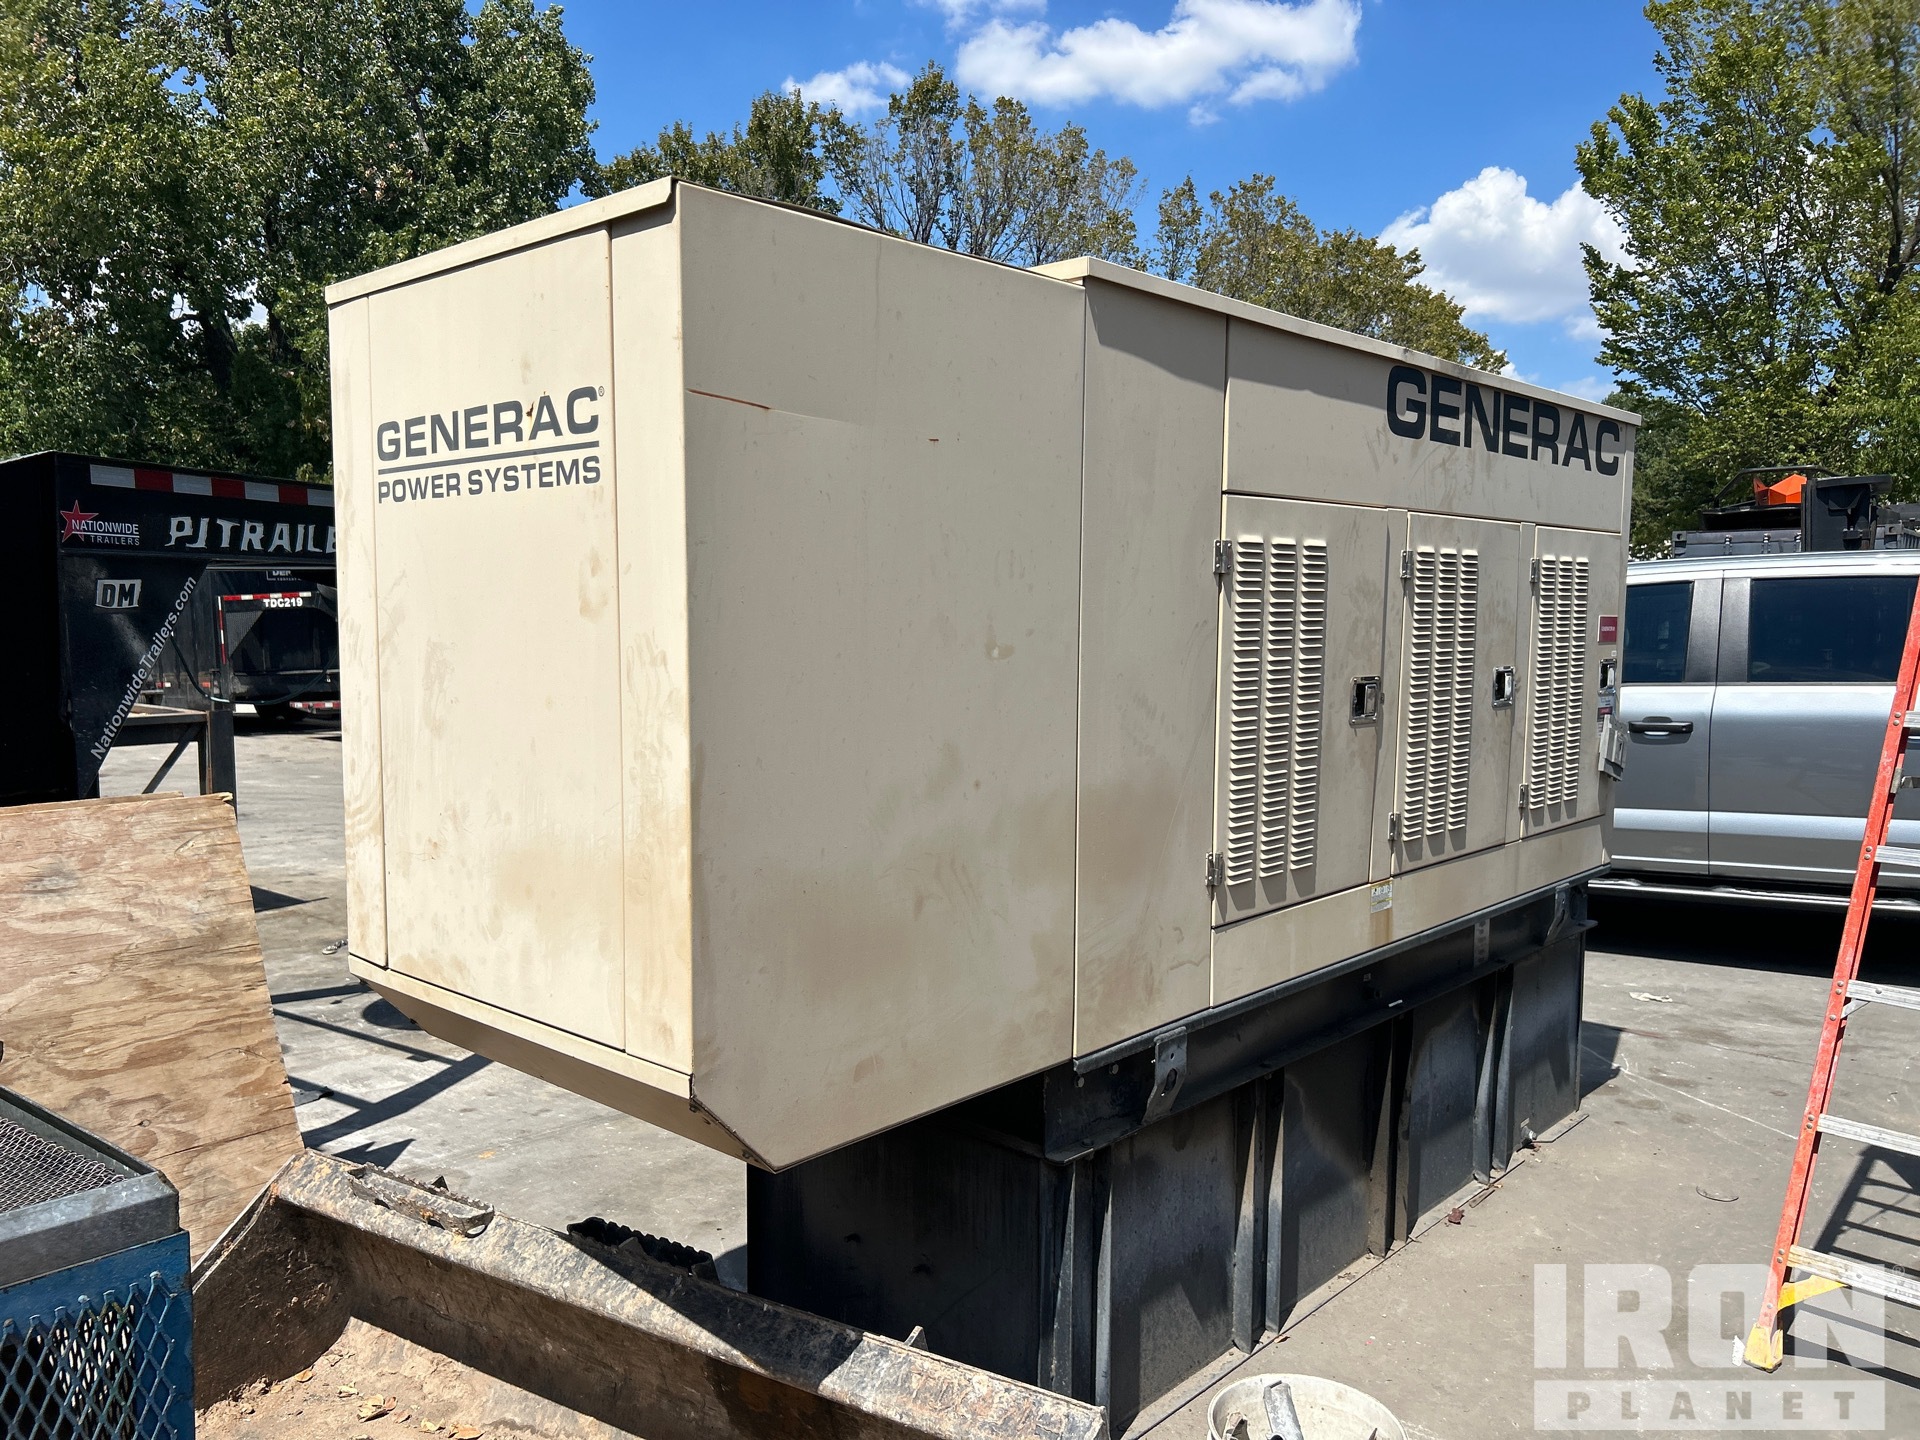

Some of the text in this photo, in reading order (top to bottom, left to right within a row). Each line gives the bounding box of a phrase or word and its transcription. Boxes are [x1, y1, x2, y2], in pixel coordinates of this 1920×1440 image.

[376, 385, 599, 462] GENERAC
[1386, 365, 1620, 477] GENERAC
[378, 455, 601, 503] POWER SYSTEMS
[71, 518, 140, 535] NATIONWIDE
[90, 534, 140, 546] TRAILERS
[101, 583, 137, 608] DM
[262, 597, 303, 608] TDC219
[90, 576, 197, 761] NationwideTrailers.com
